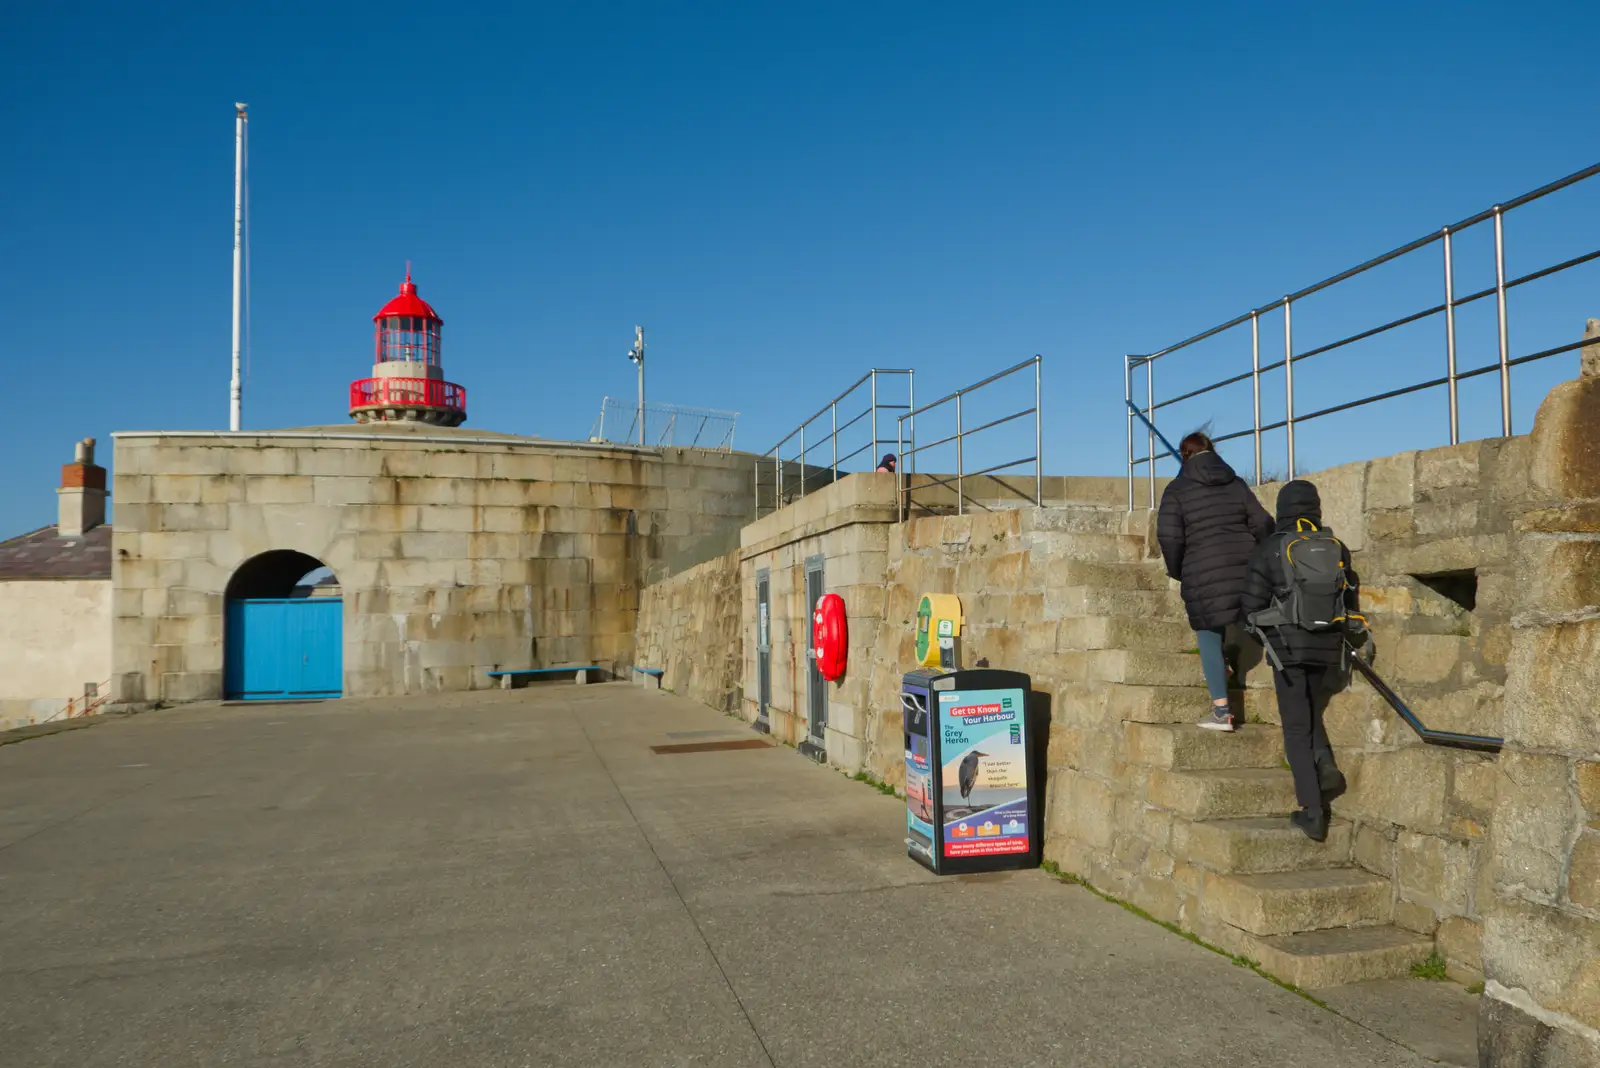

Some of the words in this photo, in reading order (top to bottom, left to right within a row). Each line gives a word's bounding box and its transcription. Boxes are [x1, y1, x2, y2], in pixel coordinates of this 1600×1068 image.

[952, 708, 966, 716] Get
[978, 706, 999, 714] Know
[983, 713, 1014, 722] Harbour
